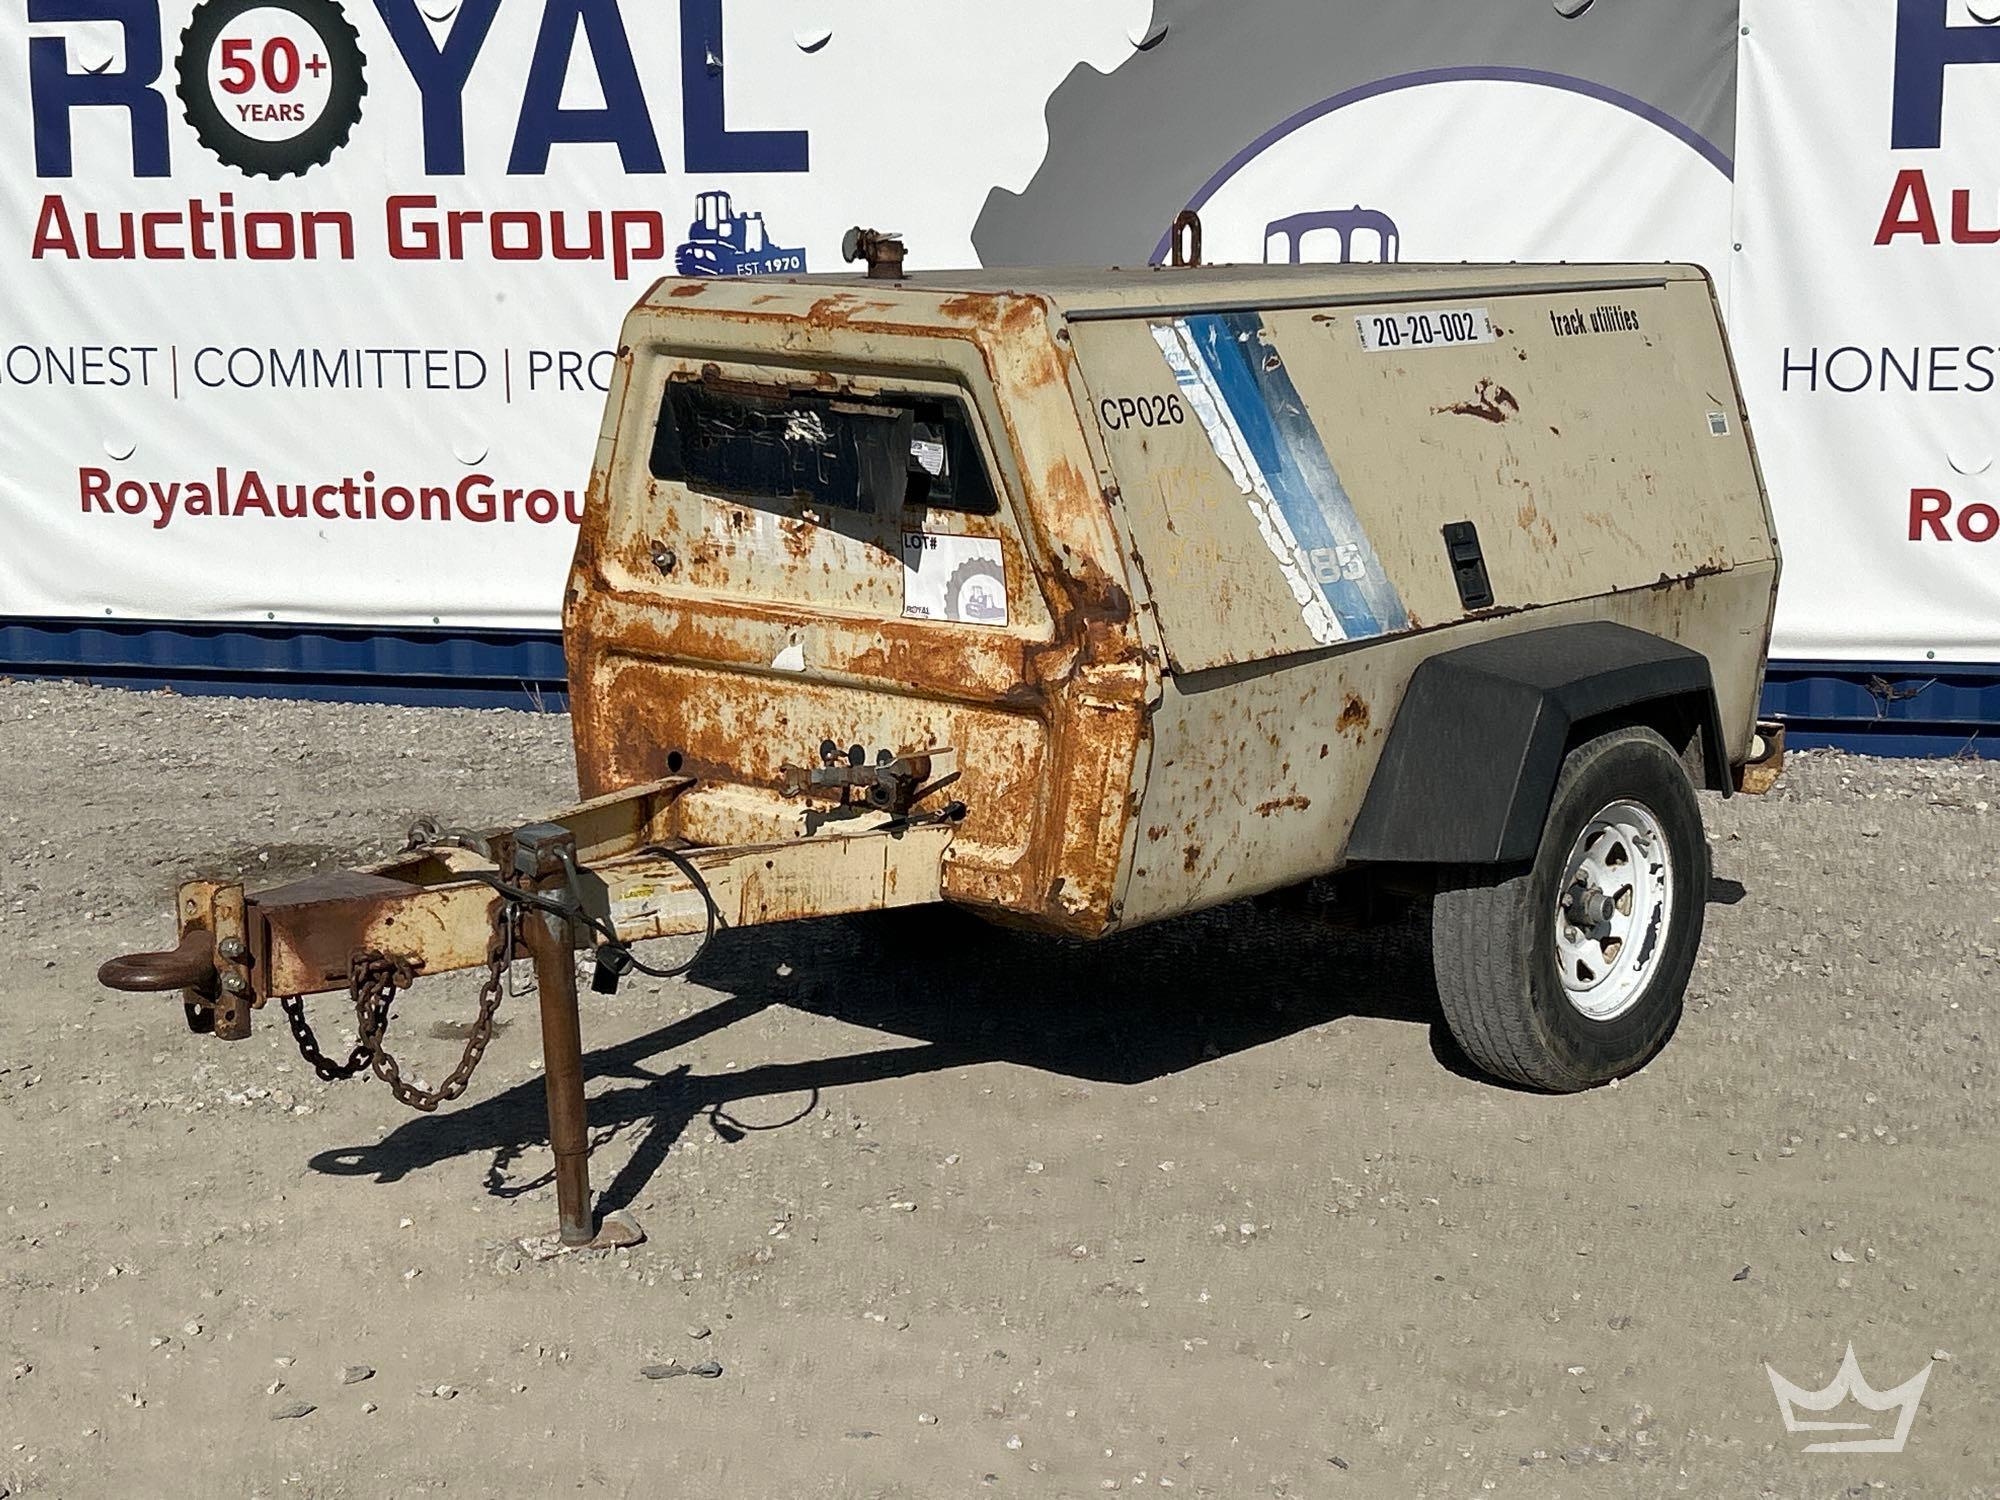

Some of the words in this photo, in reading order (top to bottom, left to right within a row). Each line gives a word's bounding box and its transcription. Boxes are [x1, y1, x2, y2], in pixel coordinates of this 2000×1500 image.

[219, 37, 328, 94] 50+
[237, 103, 305, 122] YEARS
[32, 193, 354, 261] Auction
[386, 194, 665, 281] Group
[737, 262, 763, 276] EST.
[765, 256, 800, 272] 1970
[1373, 312, 1478, 347] 20-20-002
[1550, 308, 1586, 337] track
[1591, 304, 1640, 333] utilities
[0, 345, 158, 386] ONEST
[194, 347, 488, 391] COMMITTED
[1782, 345, 2000, 392] HONES
[1100, 393, 1185, 431] CP026
[1908, 488, 2000, 543] Ro
[904, 533, 938, 550] LOT#
